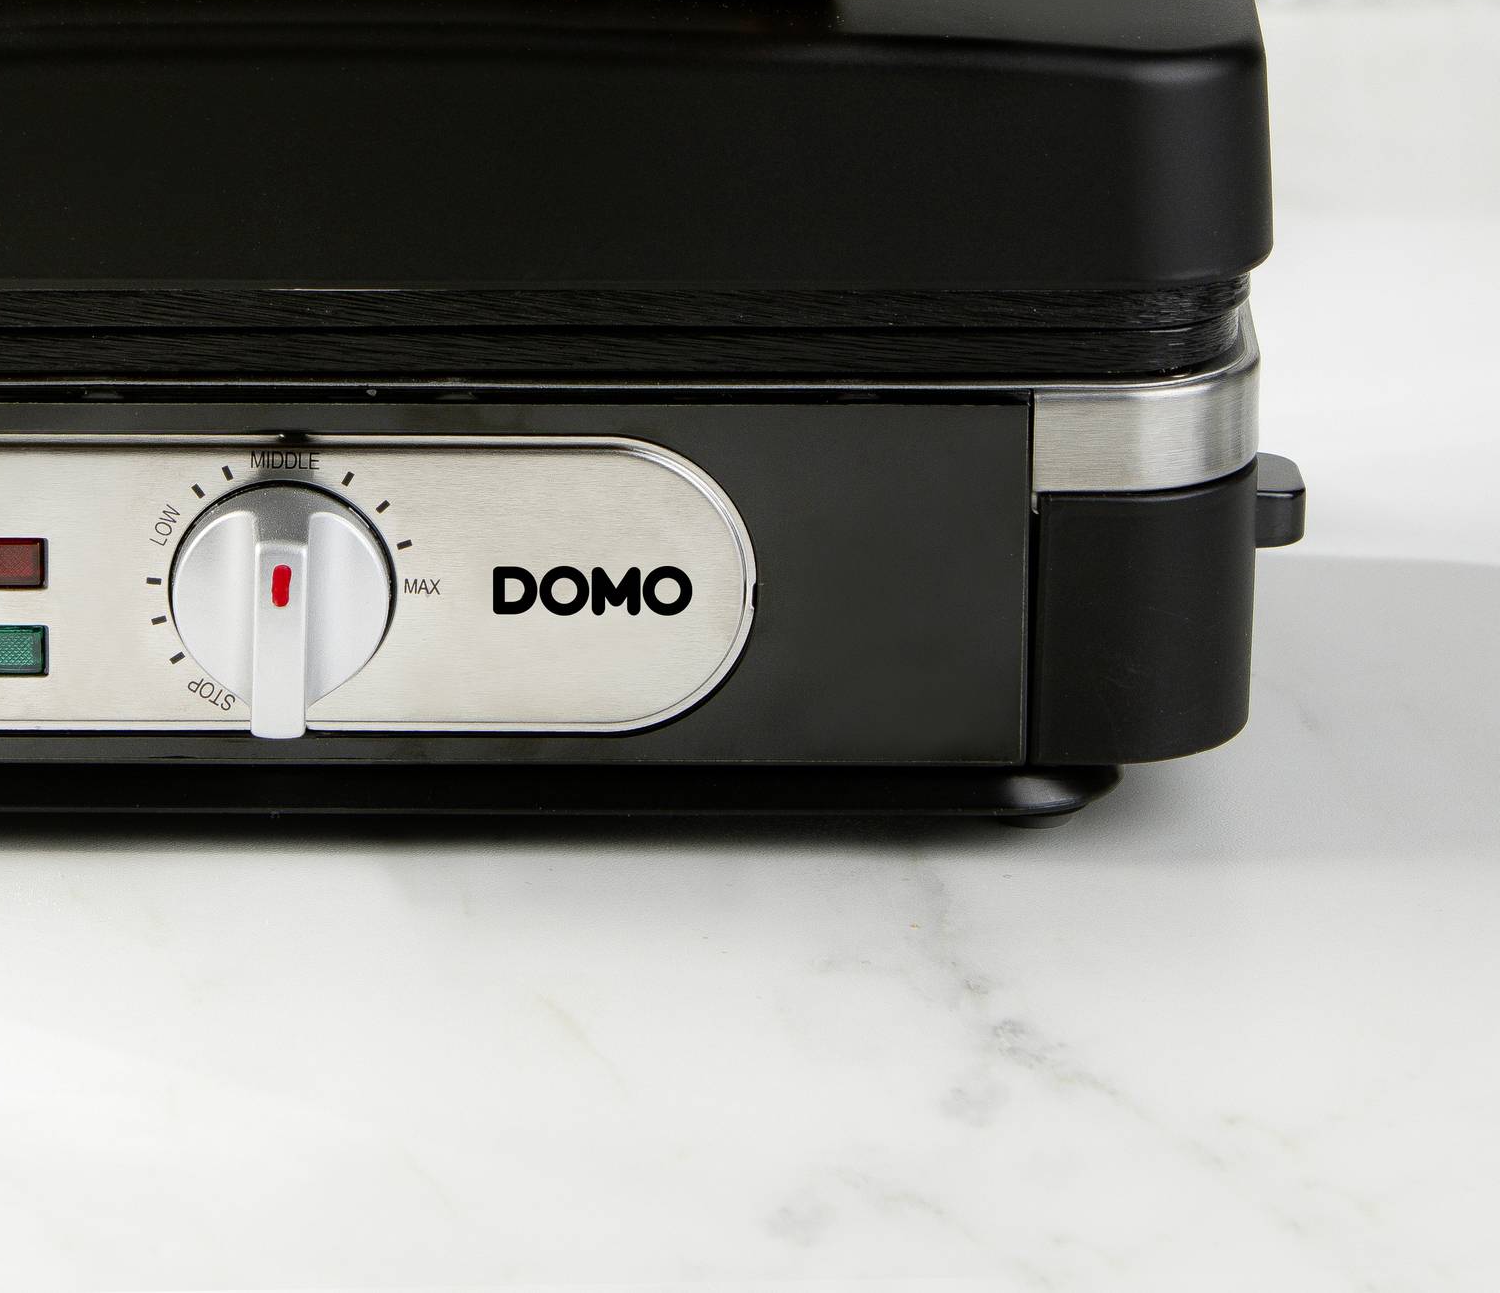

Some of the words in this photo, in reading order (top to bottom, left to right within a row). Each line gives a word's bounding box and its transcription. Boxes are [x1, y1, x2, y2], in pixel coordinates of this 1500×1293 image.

[250, 450, 320, 470] MIDDLE
[149, 503, 181, 547] LOW
[403, 577, 441, 596] MAX
[492, 566, 693, 617] DOMO
[187, 677, 236, 711] STOP
